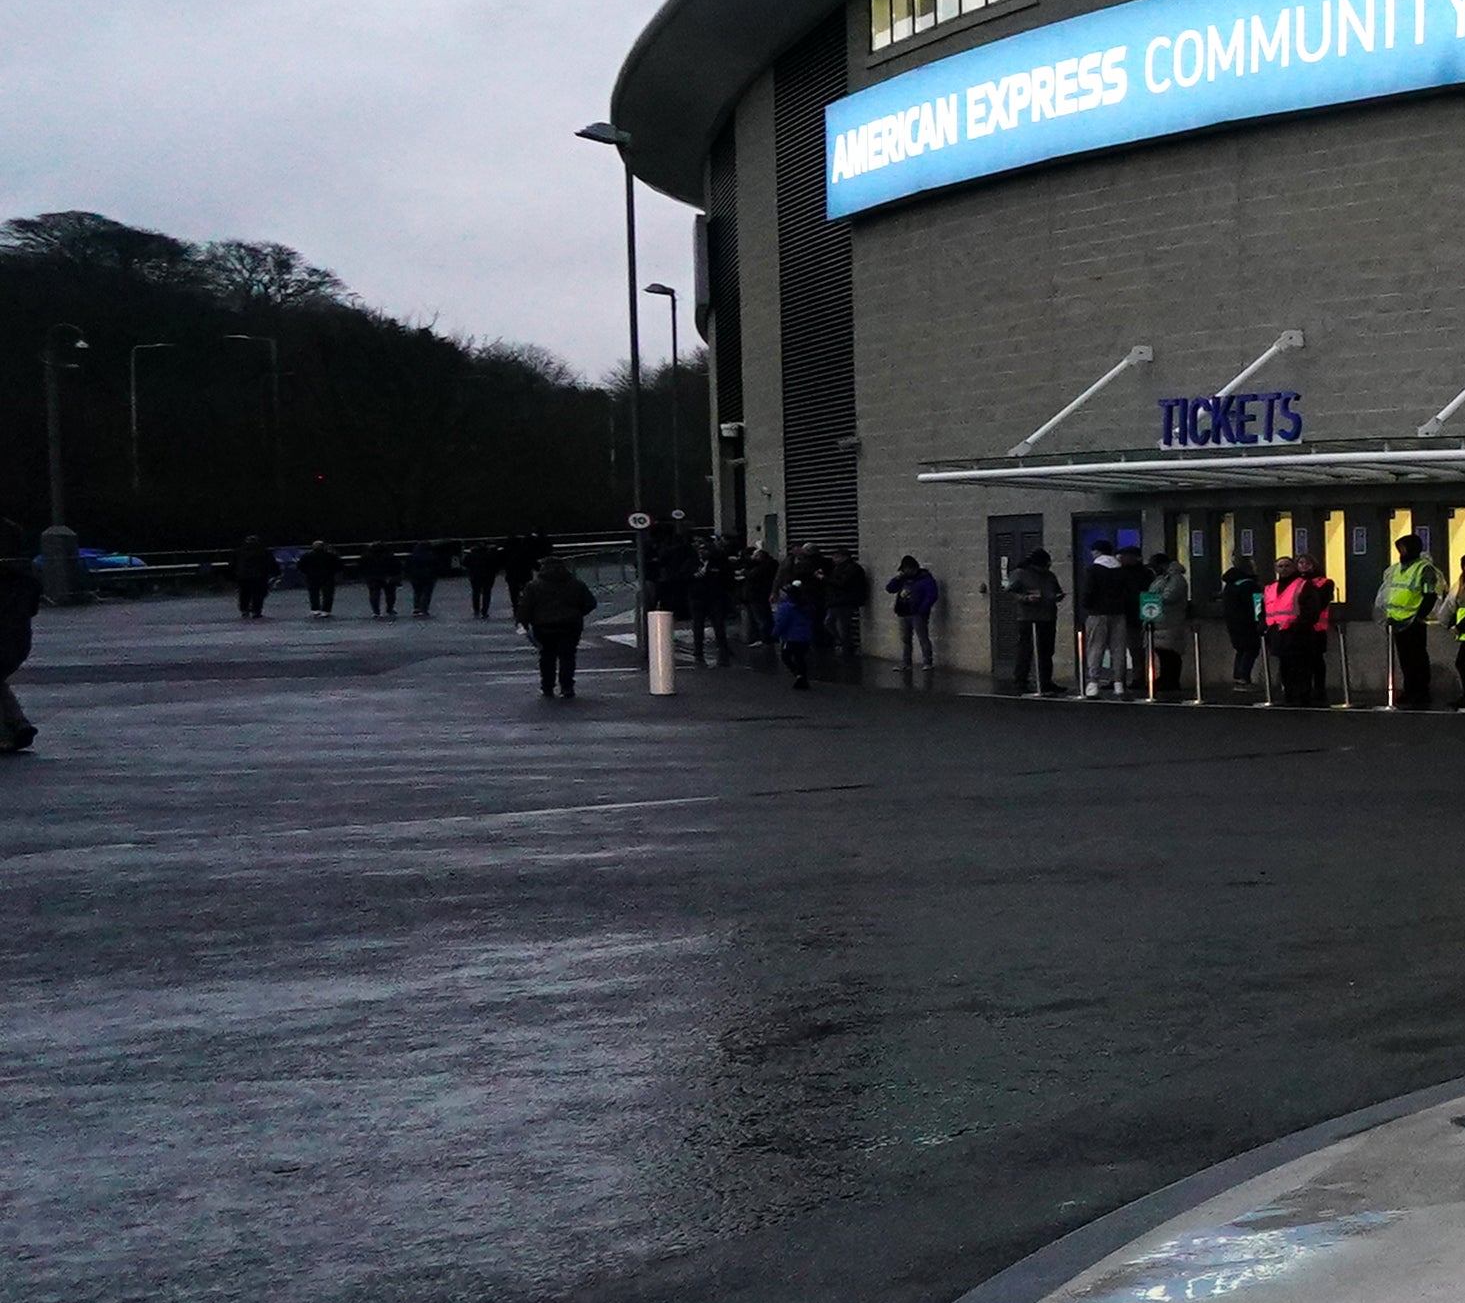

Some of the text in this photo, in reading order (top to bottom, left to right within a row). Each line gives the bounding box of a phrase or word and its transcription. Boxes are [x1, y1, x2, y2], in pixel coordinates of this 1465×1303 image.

[832, 93, 958, 184] AMERICAN
[966, 45, 1128, 138] EXPRESS
[1158, 391, 1303, 447] TICKETS
